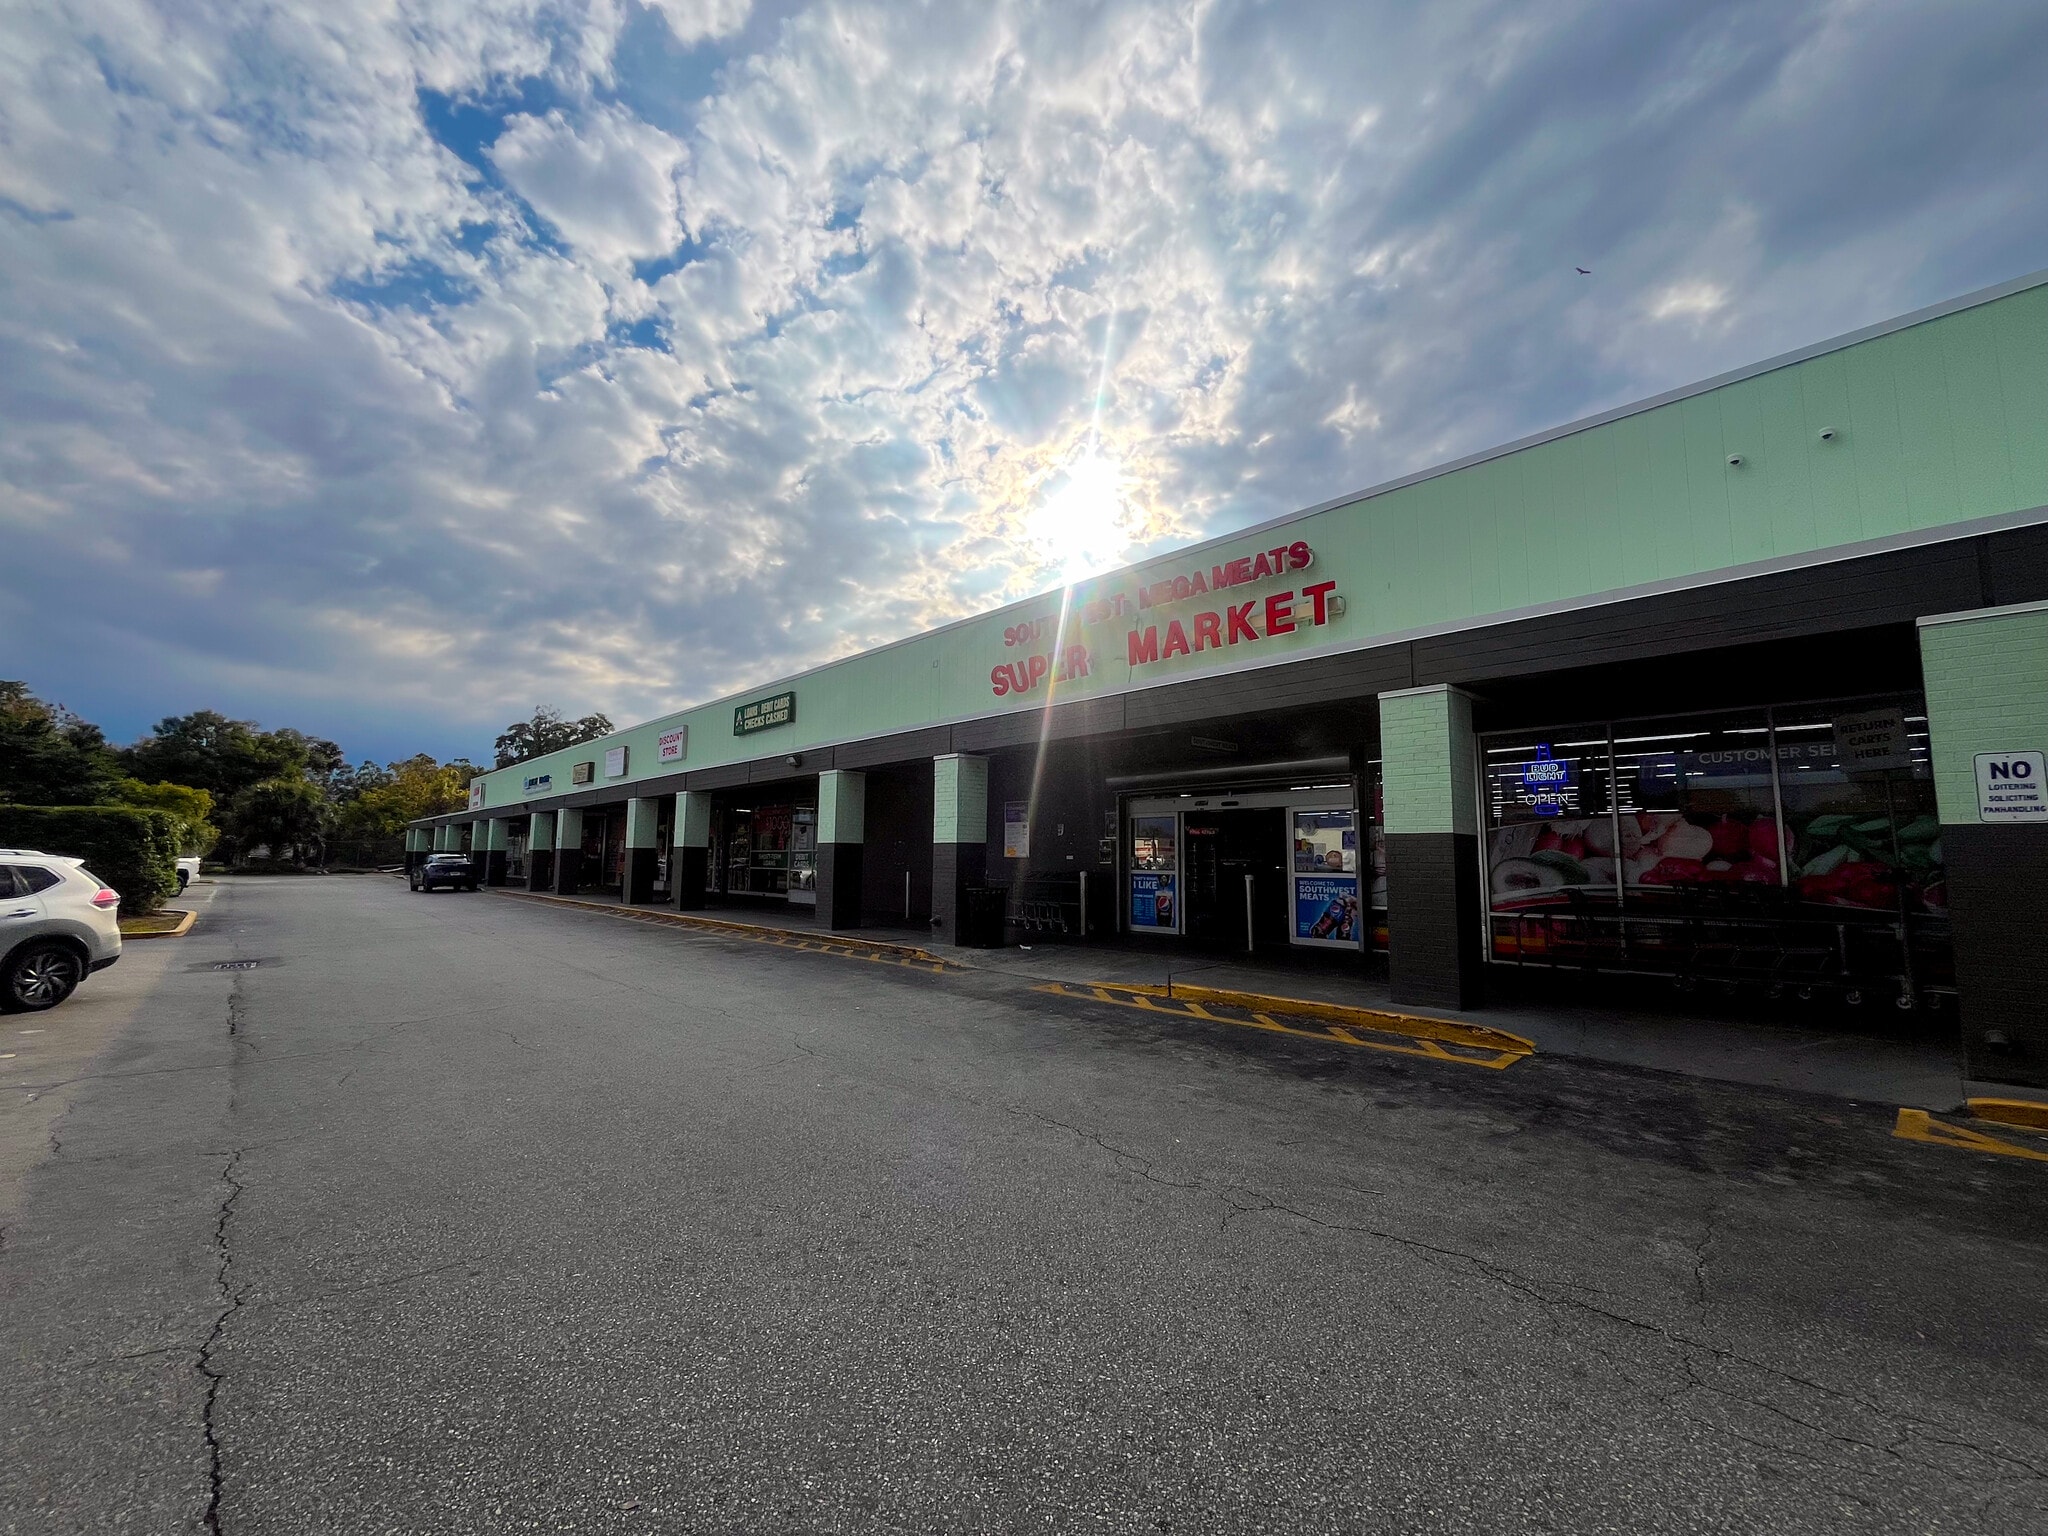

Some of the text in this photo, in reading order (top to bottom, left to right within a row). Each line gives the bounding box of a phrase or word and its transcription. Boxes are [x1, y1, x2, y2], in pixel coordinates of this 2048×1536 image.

[1004, 540, 1312, 647] SOUTEST MEGA MEATS
[991, 580, 1337, 697] SUPER MARKET
[744, 715, 765, 730] CHECKS
[766, 709, 788, 725] CASHED
[1840, 717, 1895, 735] RETURN
[659, 731, 683, 746] DISCOUNT
[1849, 732, 1891, 747] CARTS
[662, 744, 678, 757] STORE
[1699, 747, 1802, 765] CUSTOMER
[1854, 746, 1891, 759] HERE
[1530, 763, 1559, 773] BUD
[1989, 760, 2032, 780] NO
[1526, 772, 1565, 782] LIGHT
[1988, 782, 2037, 791] LOITERING
[1525, 792, 1569, 806] OPEN
[1988, 794, 2039, 802] SOLICITING
[1983, 805, 2047, 814] PANHANDLING
[794, 853, 809, 861] DEBIT
[793, 860, 810, 868] CARDS
[1138, 880, 1159, 890] LIKE
[1299, 885, 1356, 895] SOUTHWEST
[1299, 892, 1330, 901] MEATS
